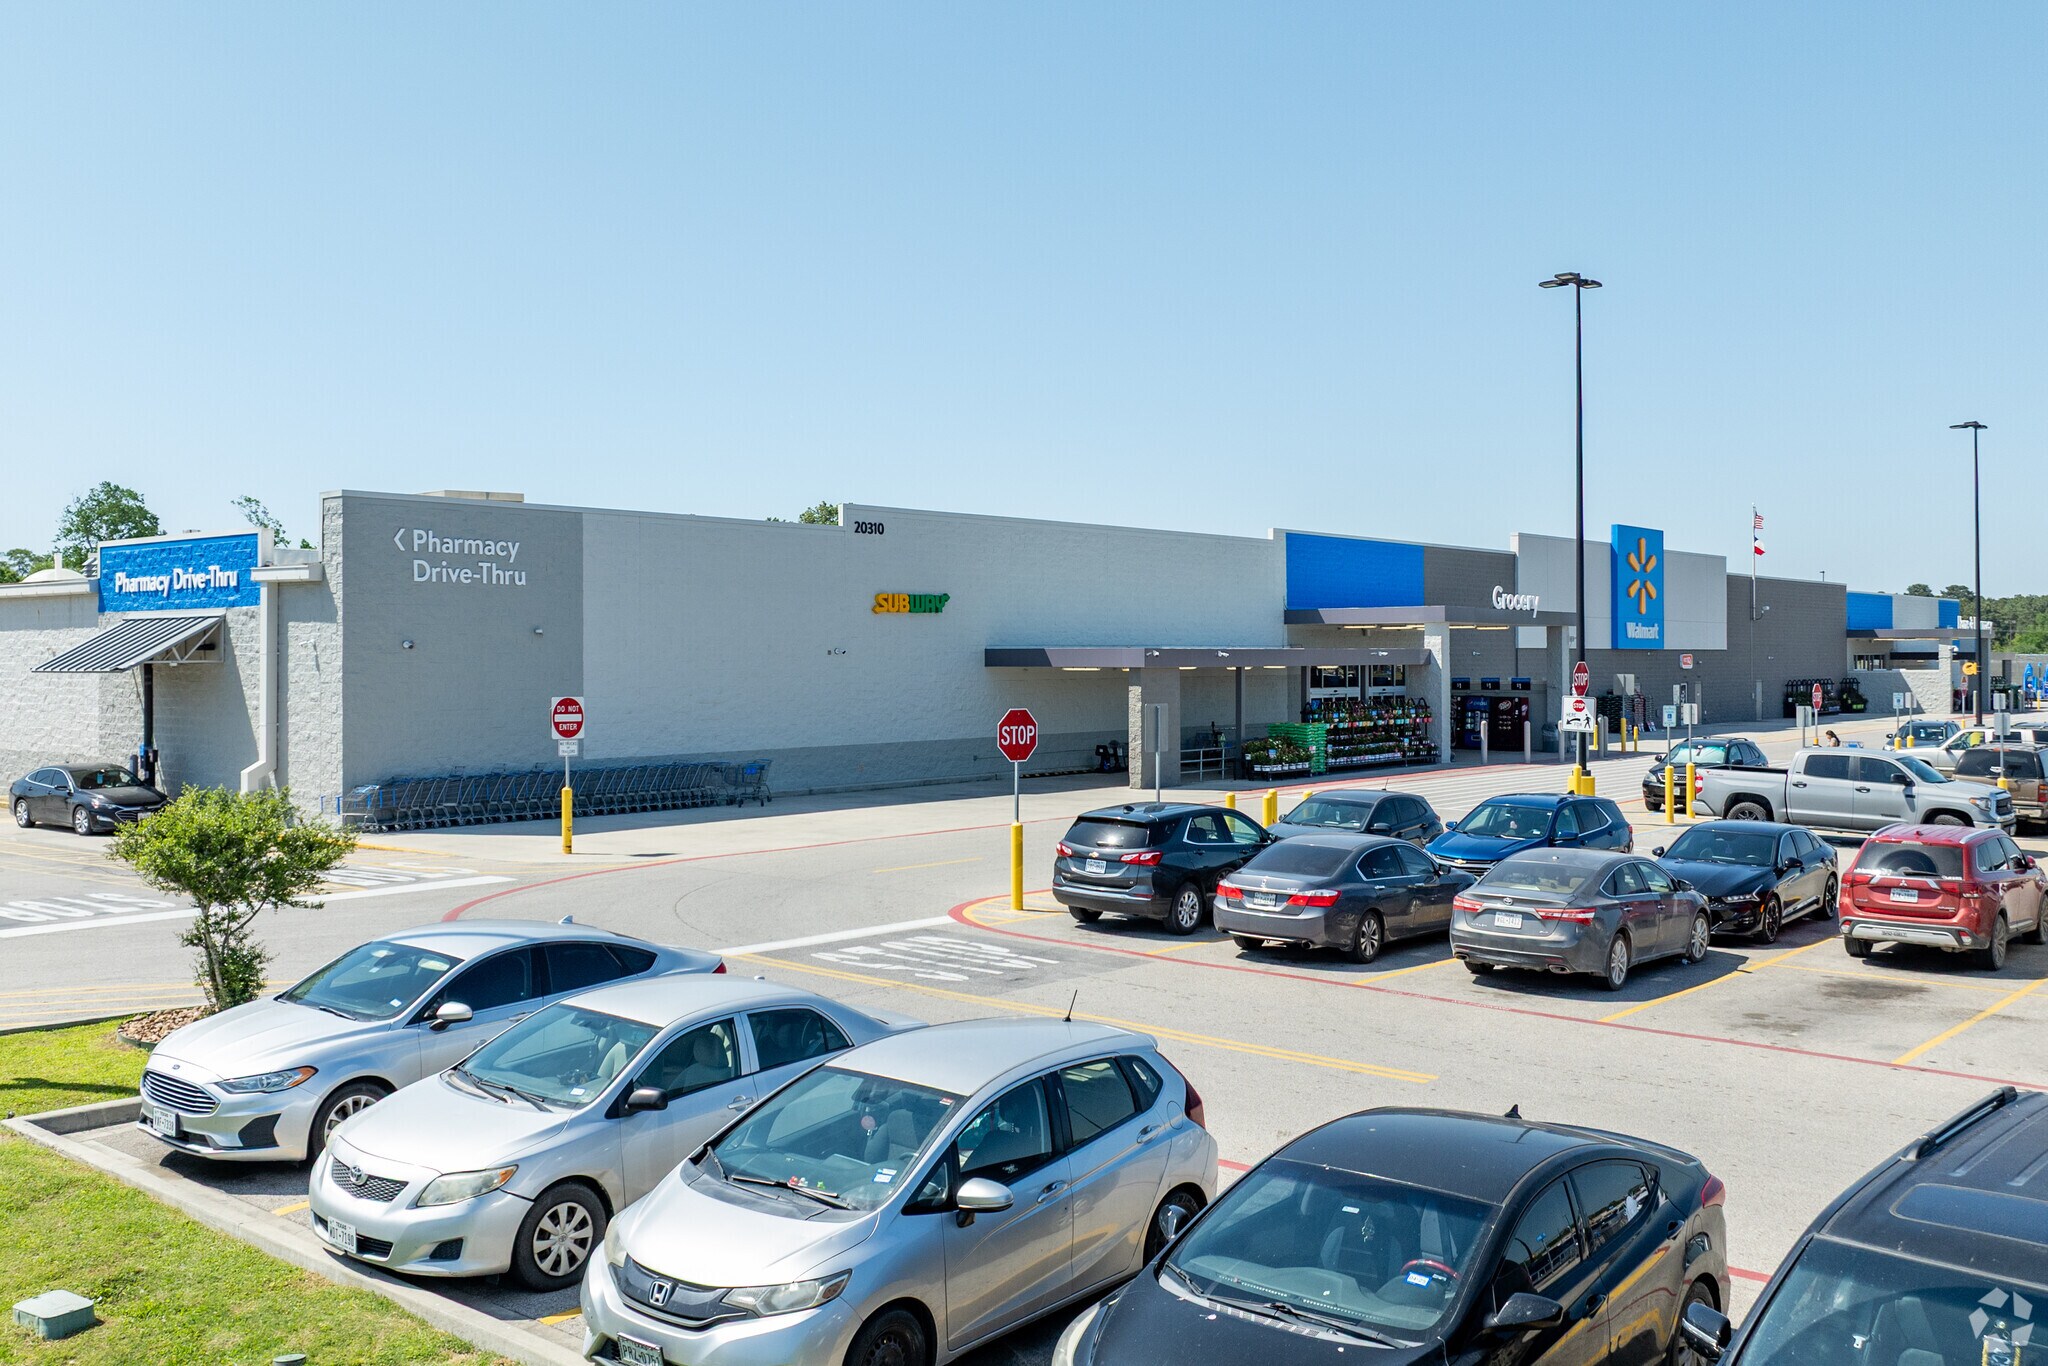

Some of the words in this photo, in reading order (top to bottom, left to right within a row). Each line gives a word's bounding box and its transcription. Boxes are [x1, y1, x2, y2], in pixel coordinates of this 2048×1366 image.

[854, 520, 885, 535] 20310
[413, 528, 520, 563] Pharmacy
[115, 572, 171, 598] Pharmacy
[173, 565, 239, 590] Drive-Thru
[413, 559, 527, 586] Drive-Thru
[872, 593, 951, 614] SUBWAY
[1492, 585, 1540, 619] Grocery
[1626, 622, 1659, 640] Walmart
[1574, 673, 1588, 686] STOP
[1001, 725, 1035, 746] STOP
